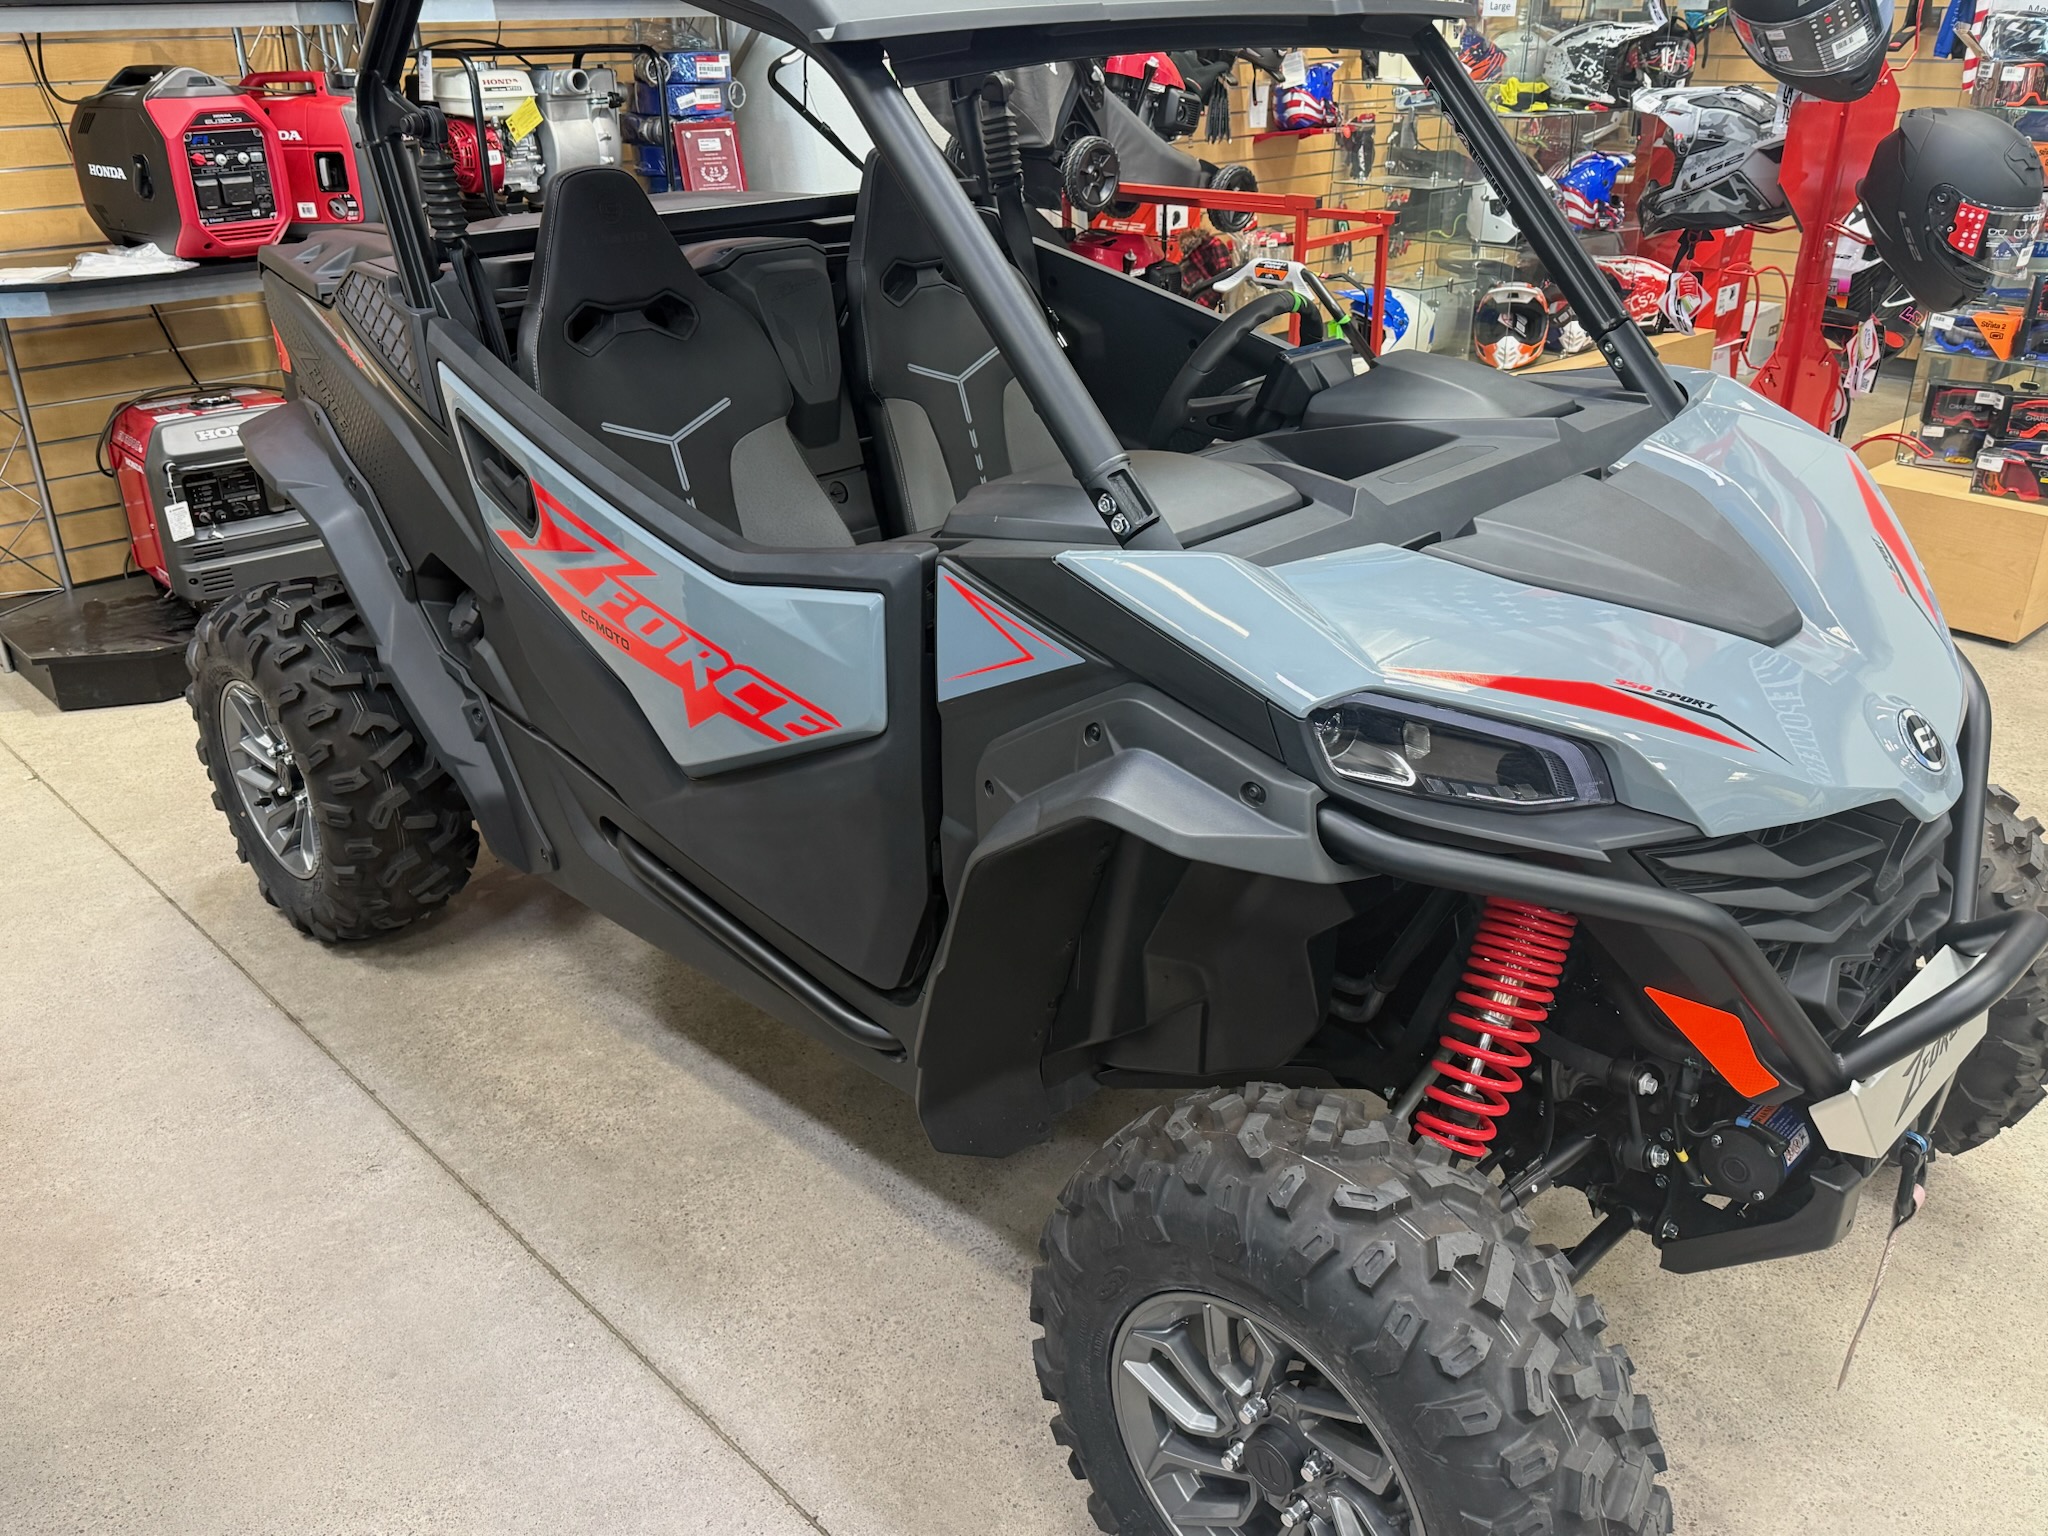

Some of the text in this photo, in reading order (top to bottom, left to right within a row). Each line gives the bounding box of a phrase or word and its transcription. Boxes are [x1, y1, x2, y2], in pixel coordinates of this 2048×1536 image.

[1489, 2, 1511, 13] Large
[1576, 57, 1605, 84] LS2
[482, 78, 520, 86] HONDA
[88, 163, 127, 181] HONDA
[1690, 152, 1745, 183] LS2
[1099, 219, 1147, 233] LS2
[1898, 210, 1923, 262] LS2
[1981, 320, 2000, 329] Strata
[1949, 402, 1983, 412] CHARGER
[2025, 415, 2048, 423] CHARG
[495, 477, 843, 744] ZFORCE
[581, 609, 629, 651] CFMOTO
[1613, 678, 1718, 709] 950 SPORT
